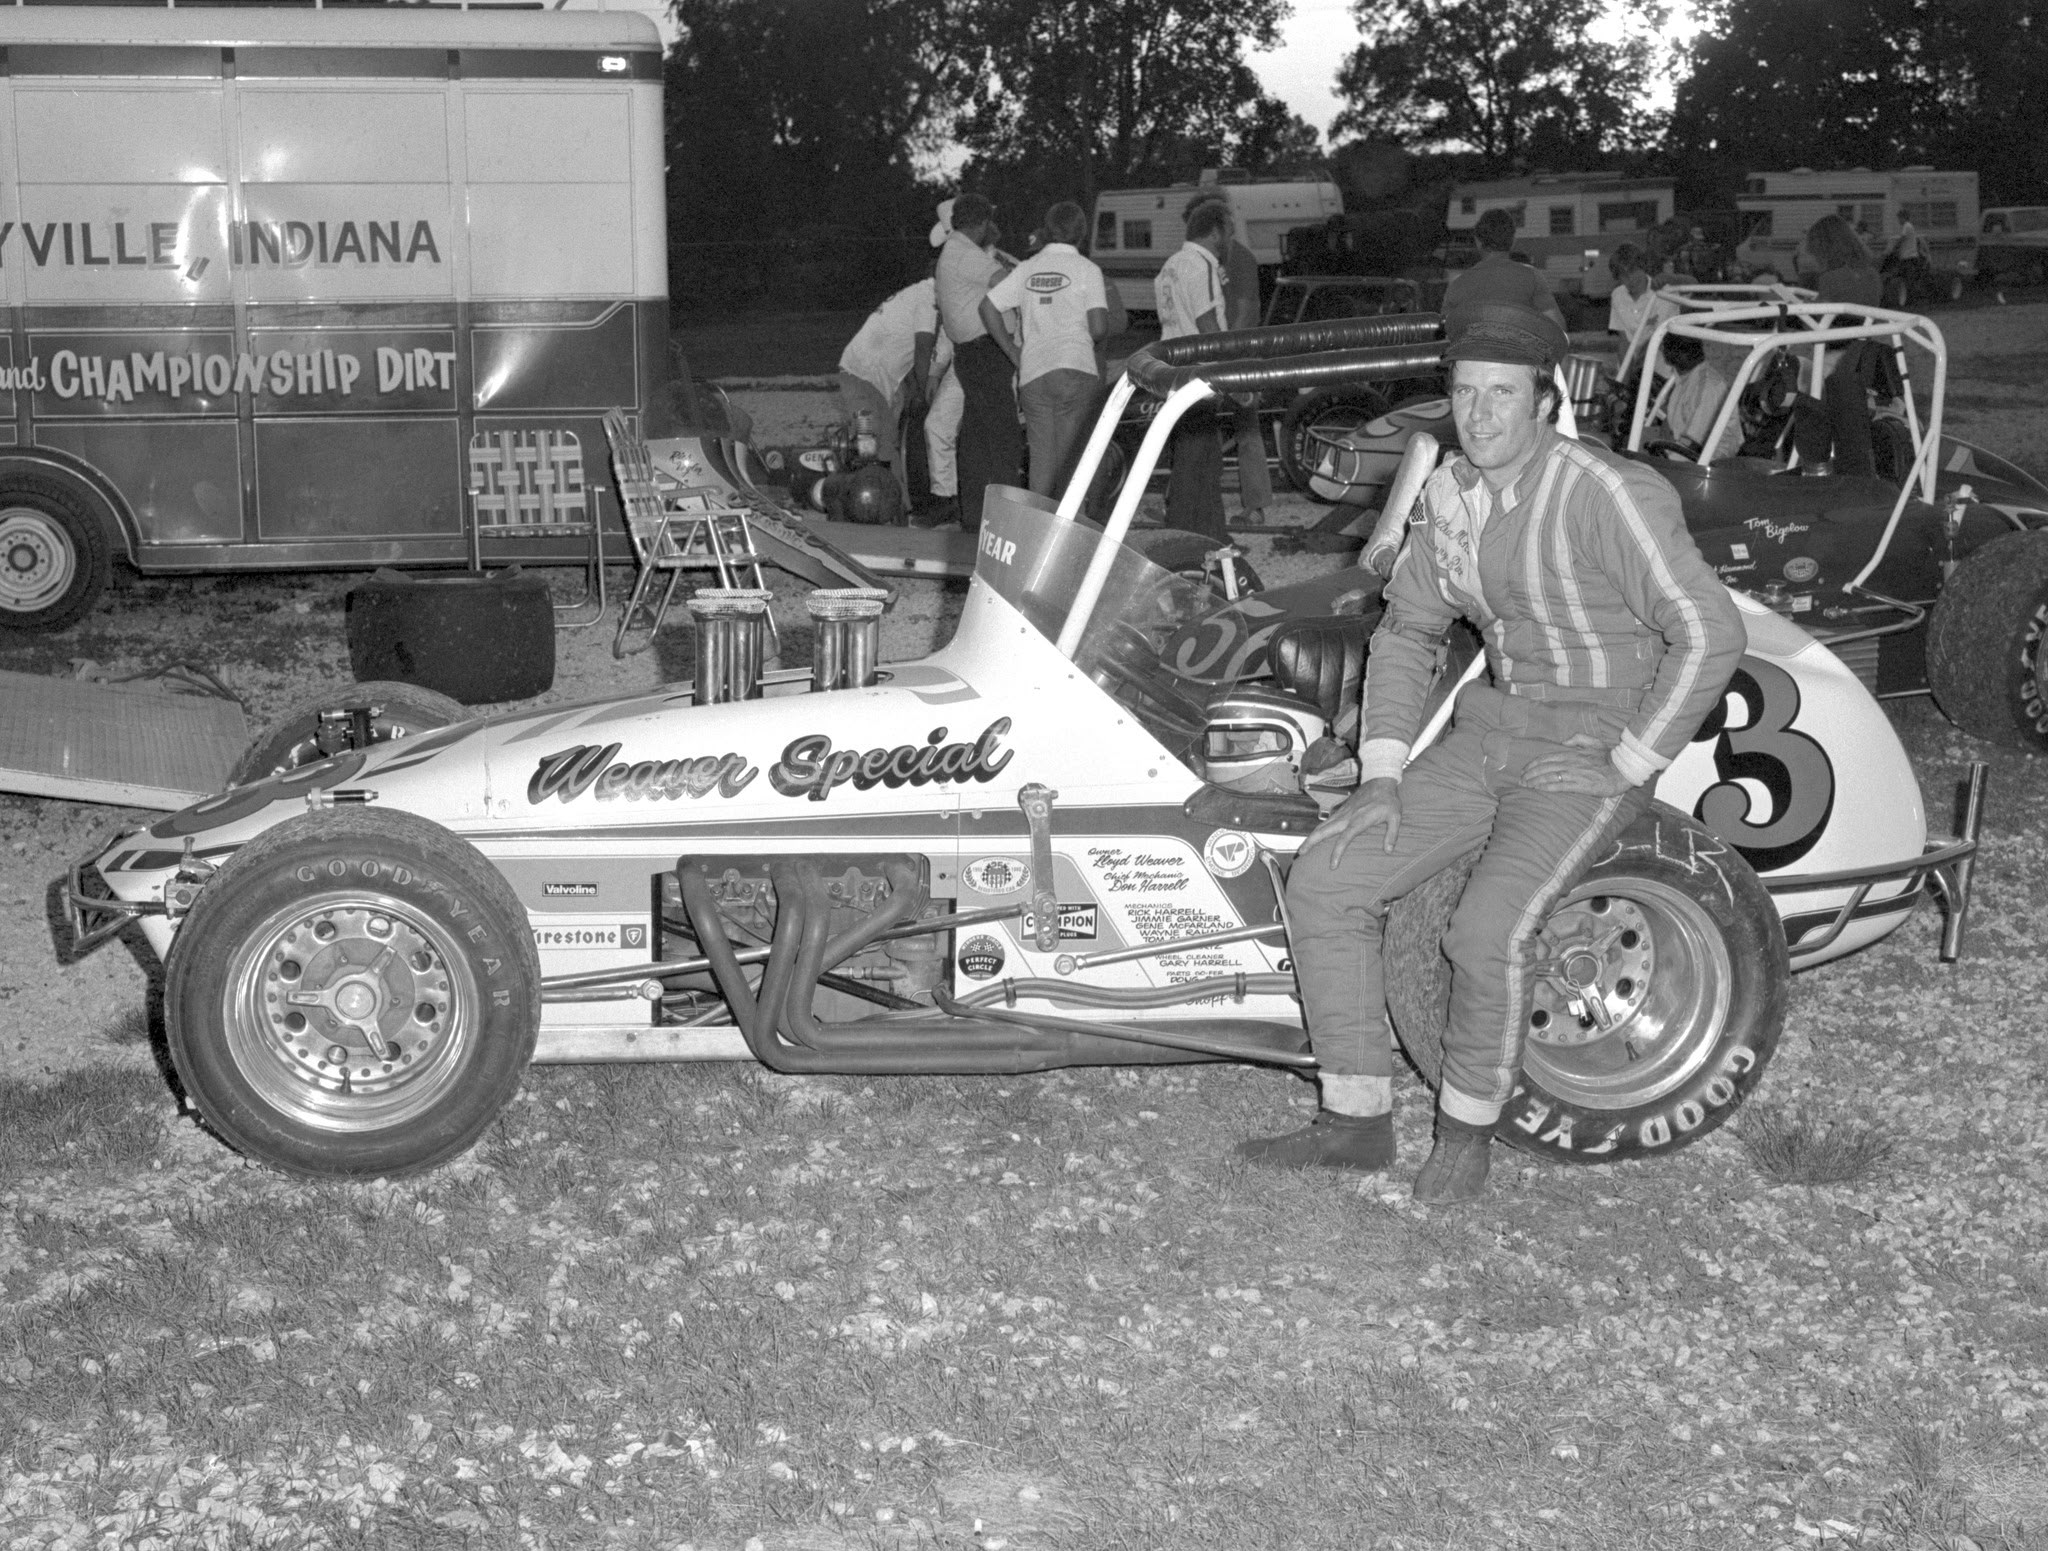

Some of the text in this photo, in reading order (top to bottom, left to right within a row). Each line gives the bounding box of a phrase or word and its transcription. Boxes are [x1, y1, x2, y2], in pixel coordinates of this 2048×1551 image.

[230, 220, 442, 269] INDIANA
[51, 348, 361, 401] CHAMPIONSHIP
[376, 346, 457, 394] DIRT
[1743, 517, 1770, 531] Tom
[1765, 522, 1810, 544] Bigelow
[527, 717, 1015, 805] Weaver Special
[1693, 655, 1836, 873] 3
[1093, 854, 1185, 871] Lloyd Weaver
[1103, 870, 1184, 882] Chief Mechanic
[546, 884, 597, 896] Valvoline
[1108, 878, 1190, 893] Don Harrell
[1131, 915, 1172, 923] JIMMIE
[1155, 908, 1206, 916] HARRELL
[1026, 915, 1093, 927] CPION
[1135, 922, 1164, 930] GENE
[296, 859, 511, 1007] GOODYEAR
[532, 928, 617, 945] irestone
[965, 956, 997, 965] PERFECT
[1159, 959, 1188, 967] GARY
[1512, 1045, 1756, 1153] GOODYE
